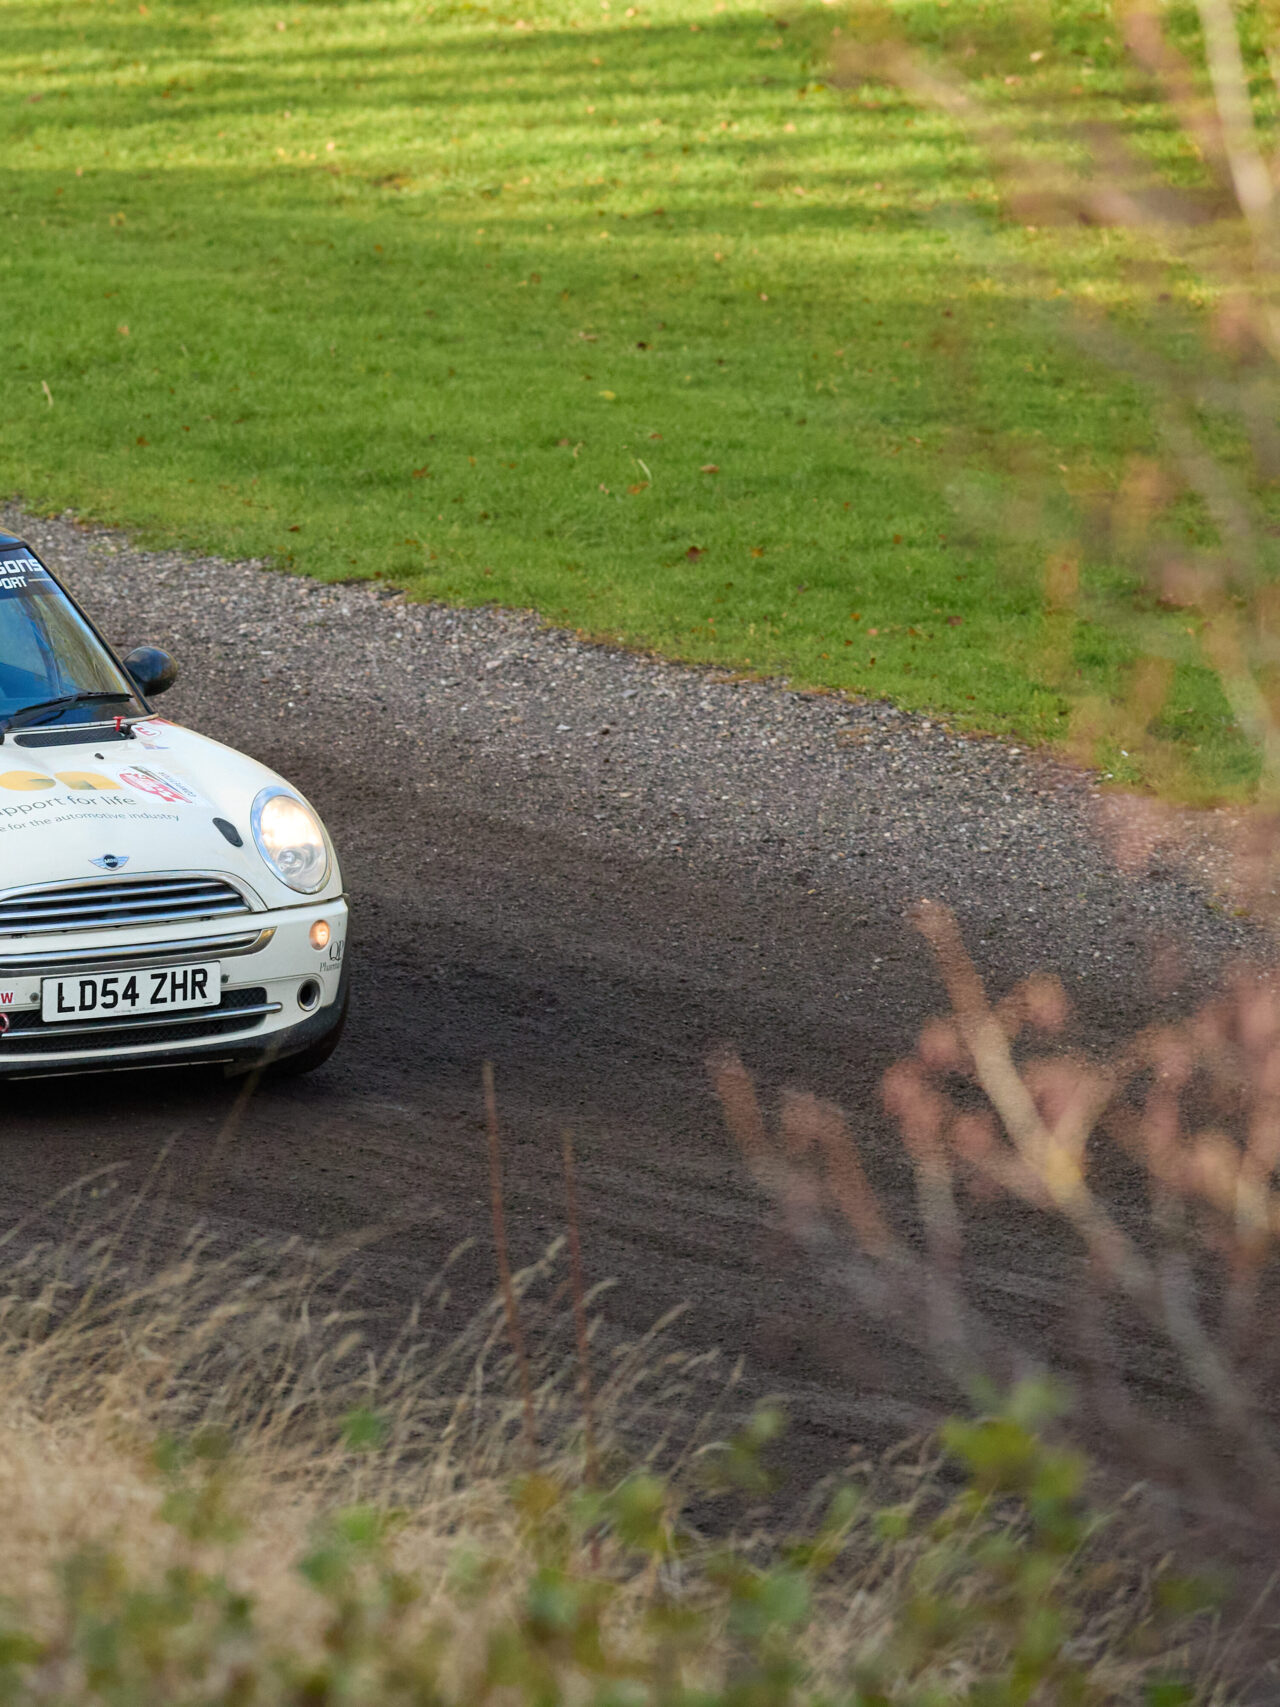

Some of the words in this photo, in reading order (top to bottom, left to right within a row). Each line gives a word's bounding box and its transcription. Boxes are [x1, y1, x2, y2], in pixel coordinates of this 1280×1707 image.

[67, 795, 98, 806] for
[102, 796, 137, 806] life
[8, 821, 28, 831] for
[29, 817, 53, 827] the
[54, 812, 128, 822] automotive
[129, 811, 180, 822] industry
[57, 975, 139, 1013] LD54
[150, 968, 208, 1005] ZHR
